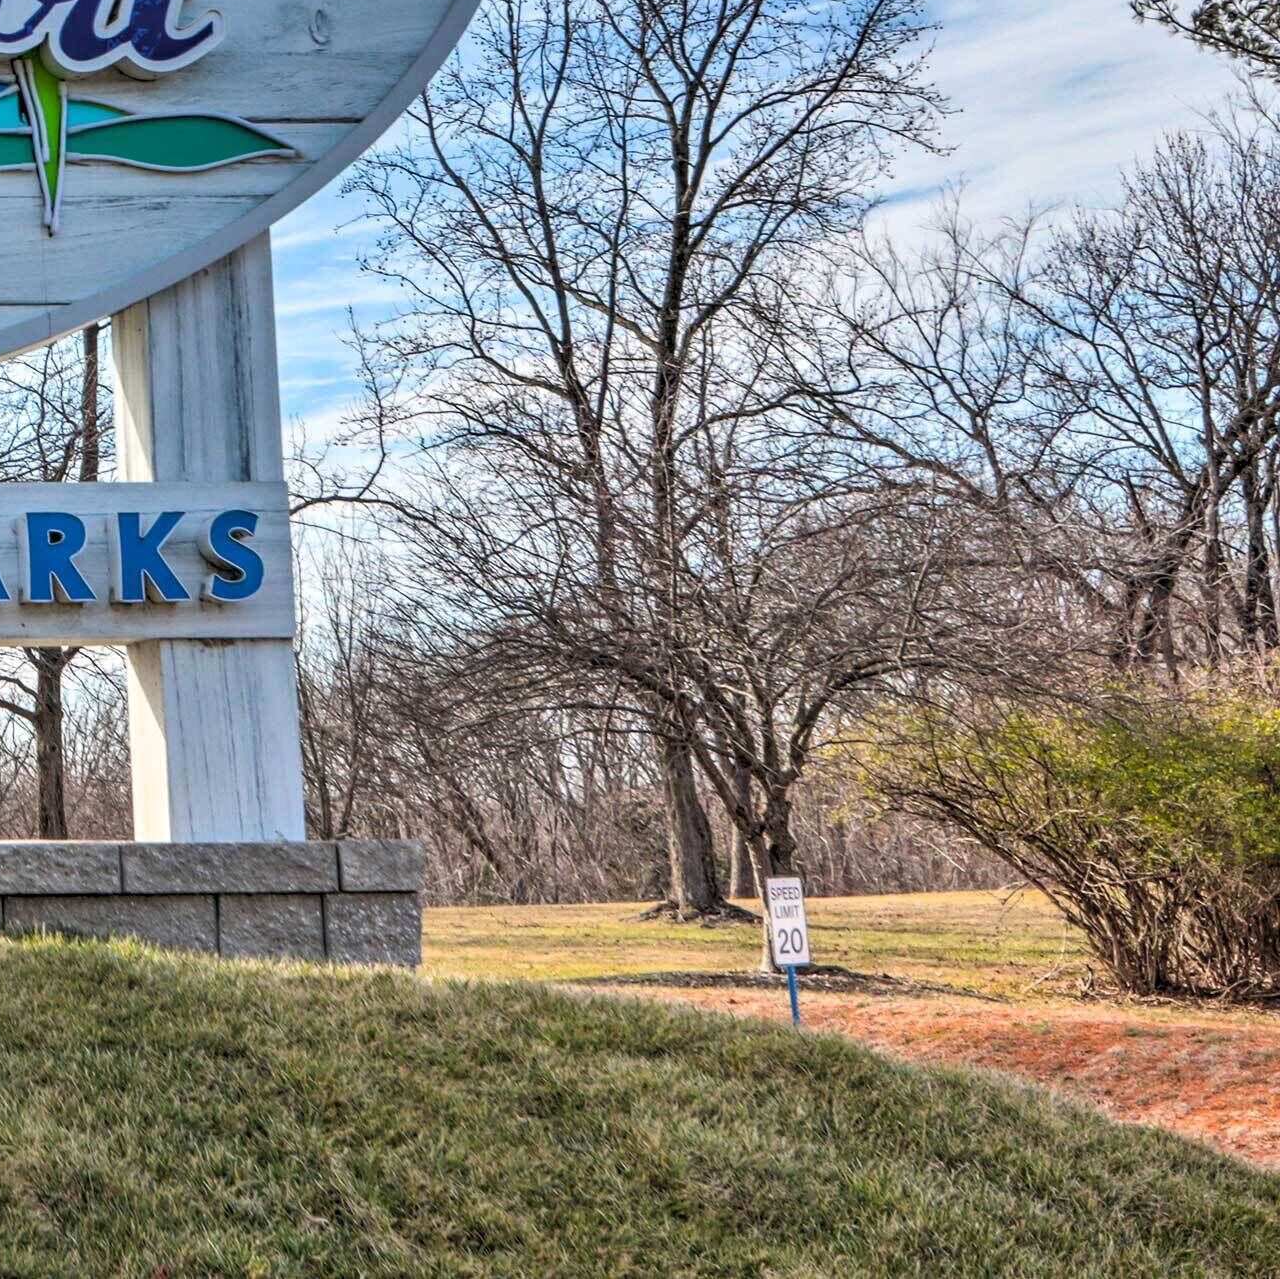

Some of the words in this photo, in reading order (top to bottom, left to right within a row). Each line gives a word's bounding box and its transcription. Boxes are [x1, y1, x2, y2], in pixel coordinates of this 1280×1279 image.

[770, 886, 801, 901] SPEED
[774, 904, 800, 919] LIMIT
[777, 927, 804, 954] 20
